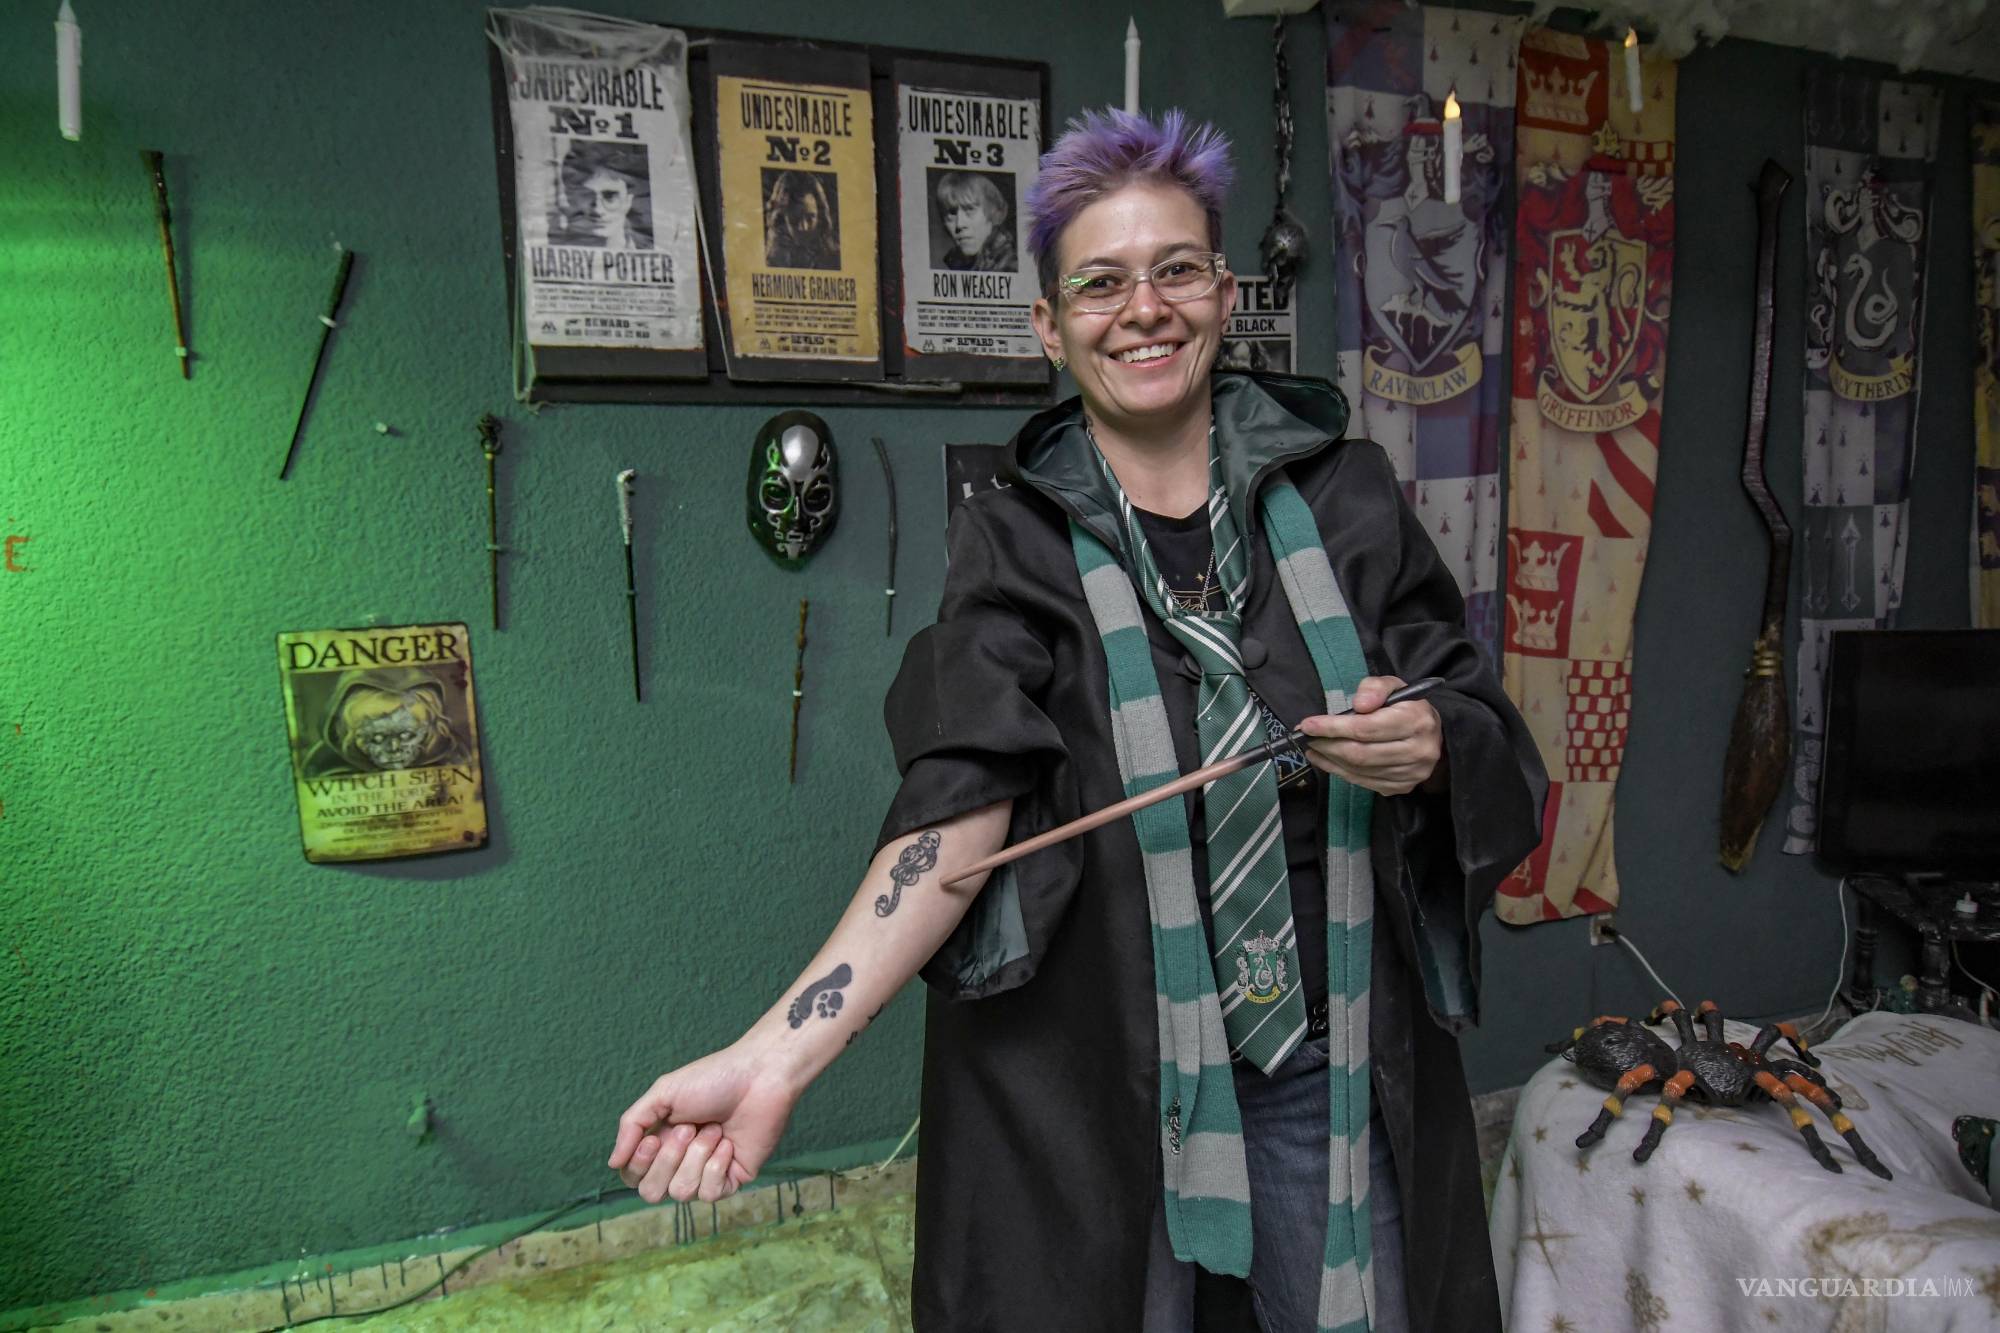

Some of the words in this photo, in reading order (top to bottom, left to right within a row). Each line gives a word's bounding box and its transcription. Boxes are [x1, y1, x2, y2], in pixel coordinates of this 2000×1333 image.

[519, 60, 664, 110] UNDESIRABLE
[741, 92, 852, 137] UNDESIRABLE
[909, 95, 1028, 139] UNDESIRABLE
[531, 248, 594, 279] HARRY
[603, 251, 674, 283] POTTER
[752, 273, 806, 299] HERMIONE
[808, 276, 857, 301] GRANGER
[934, 273, 957, 297] RON
[961, 274, 1012, 299] WEASLEY
[1236, 318, 1276, 333] BLACK
[1369, 367, 1468, 401] RAVENCLAW
[1541, 393, 1638, 427] GRYFFINDOR
[287, 632, 463, 670] DANGER
[304, 774, 397, 797] WITCH
[409, 766, 474, 786] SEEN
[317, 805, 369, 819] AVOID
[375, 801, 405, 814] THE
[414, 795, 464, 810] AREA!
